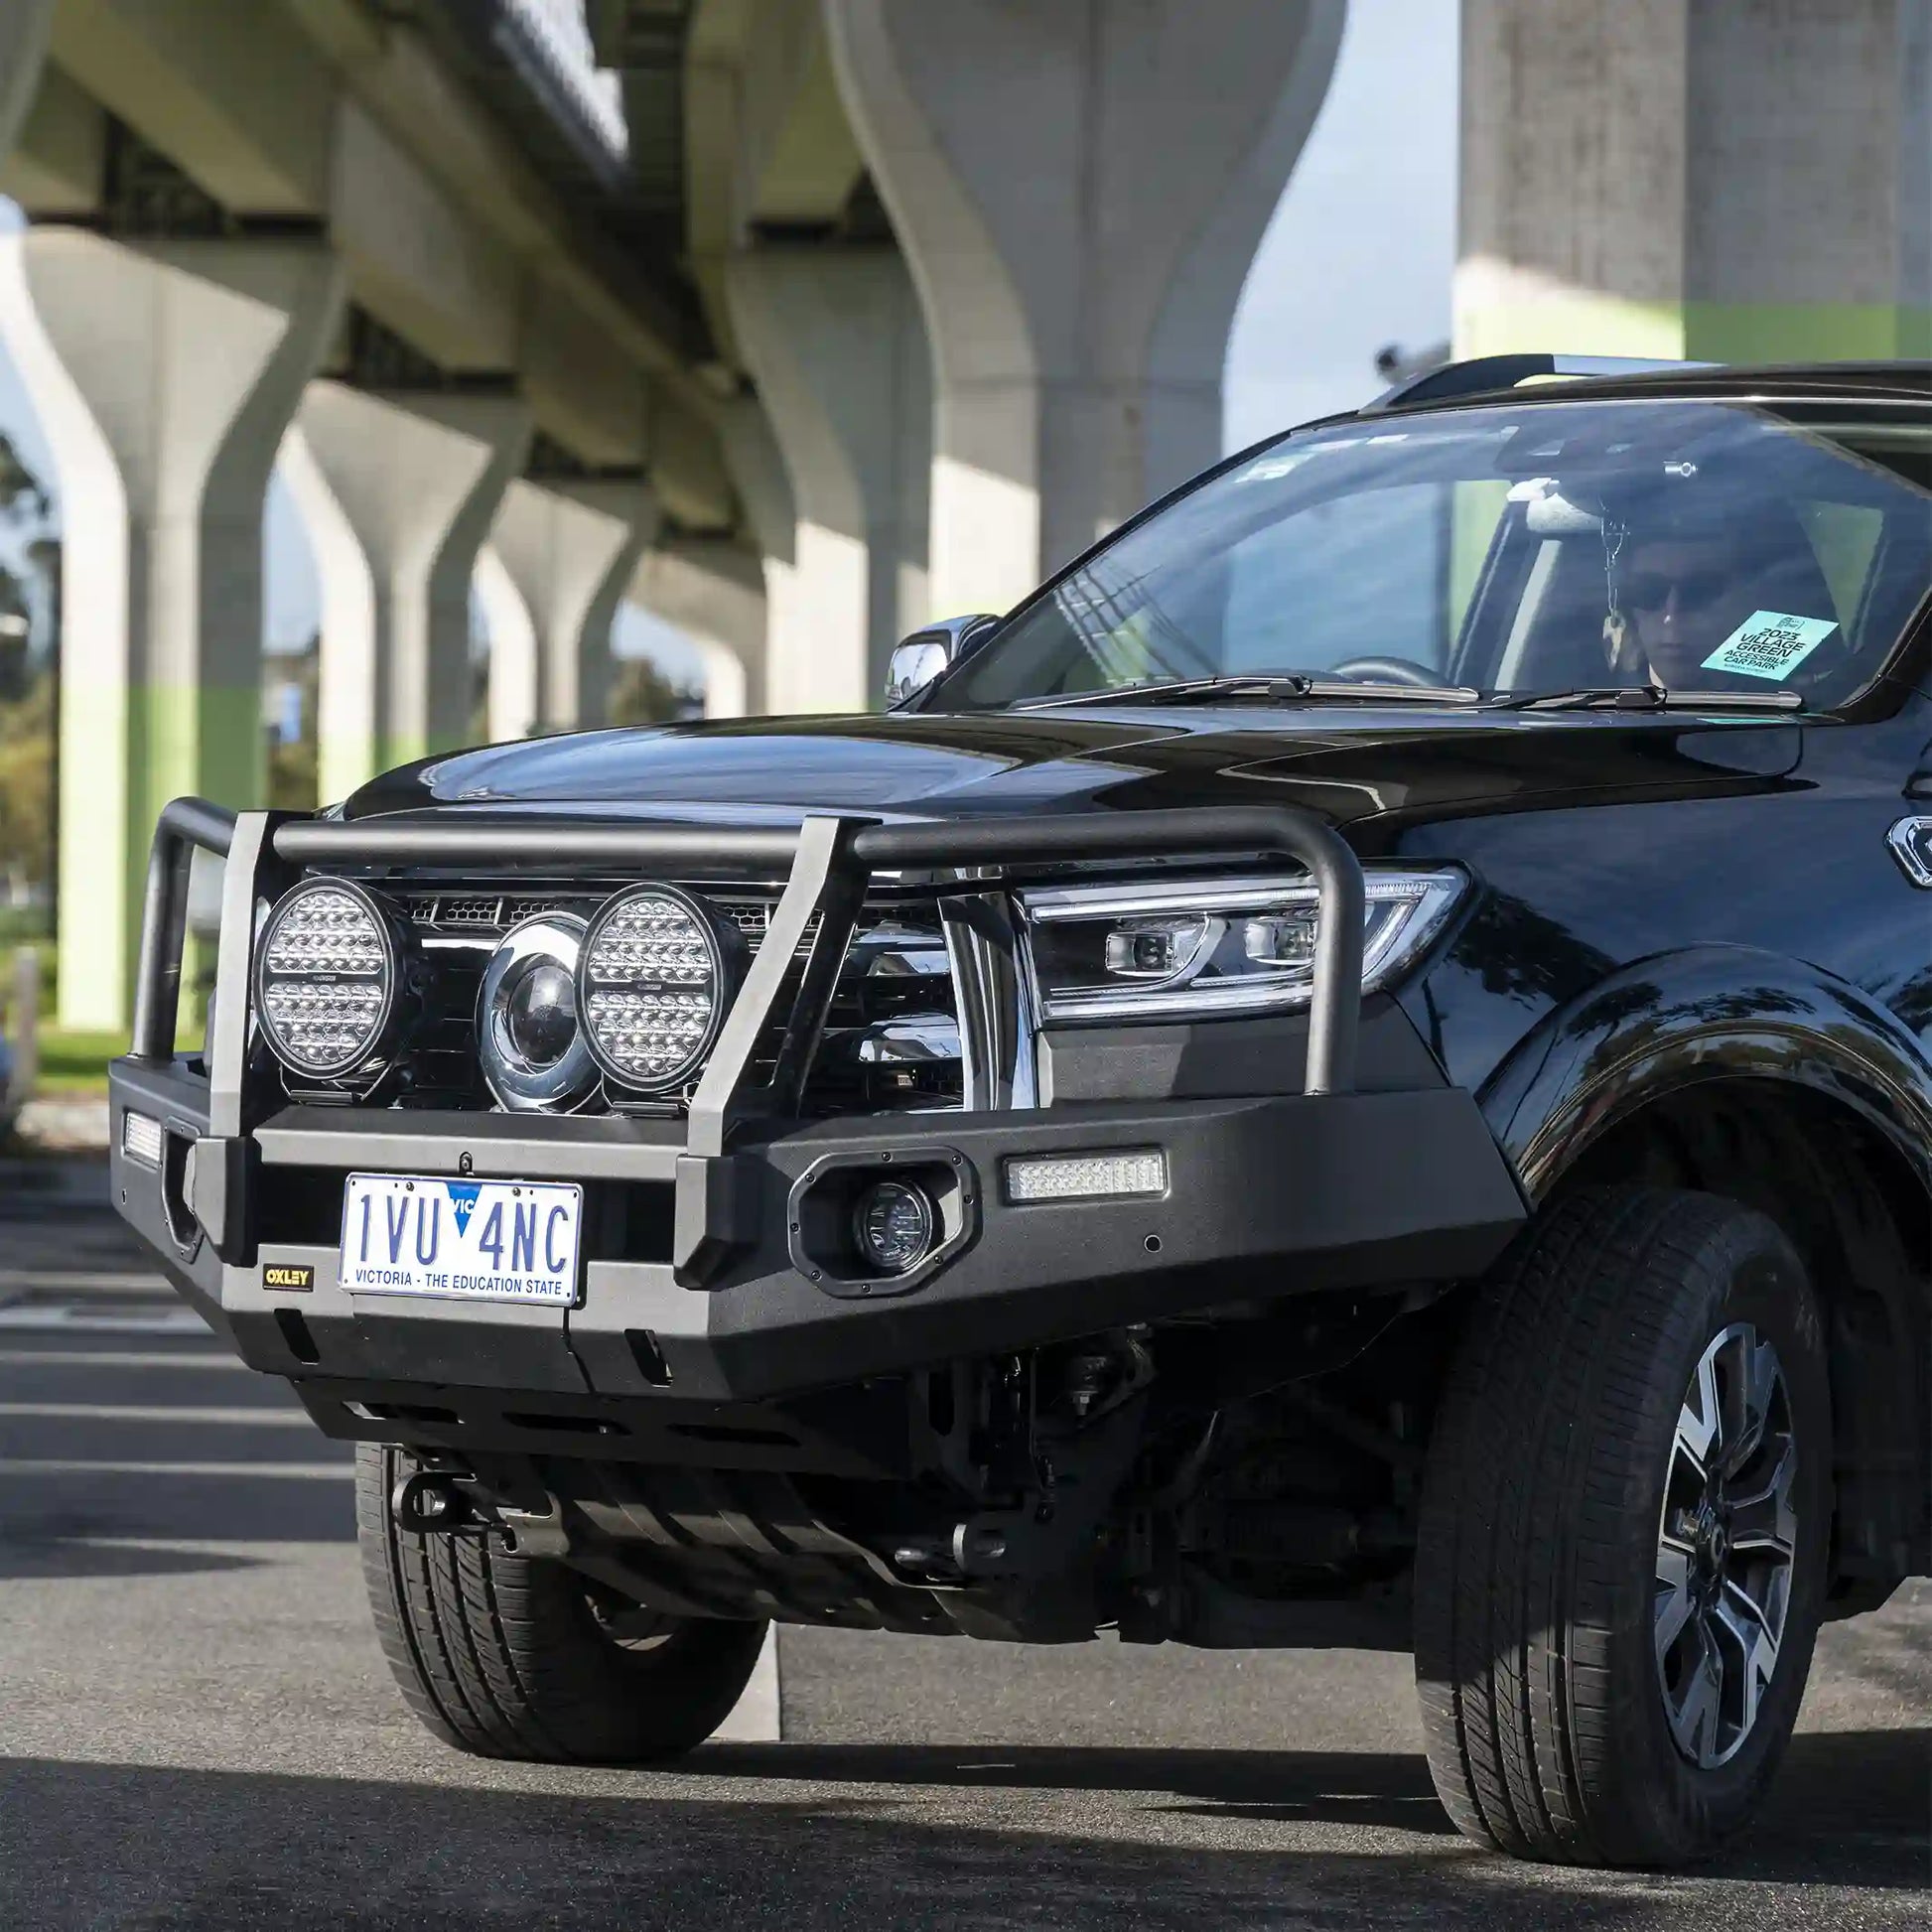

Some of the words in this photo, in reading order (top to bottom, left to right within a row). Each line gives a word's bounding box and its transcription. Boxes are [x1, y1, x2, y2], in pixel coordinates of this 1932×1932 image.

[1740, 633, 1805, 651] VILLAGE
[1758, 628, 1801, 640] 2023
[1725, 650, 1789, 665] ACCESSIBLE
[1736, 642, 1793, 657] GREEN
[1747, 659, 1777, 670] PARK
[453, 1198, 476, 1214] VIC
[359, 1194, 441, 1266] 1VU
[479, 1201, 569, 1274] 4NC
[266, 1269, 309, 1286] OXLEY
[355, 1269, 412, 1286] VICTORIA
[425, 1274, 448, 1288] THE
[453, 1276, 522, 1293] EDUCATION
[526, 1280, 562, 1295] STATE
